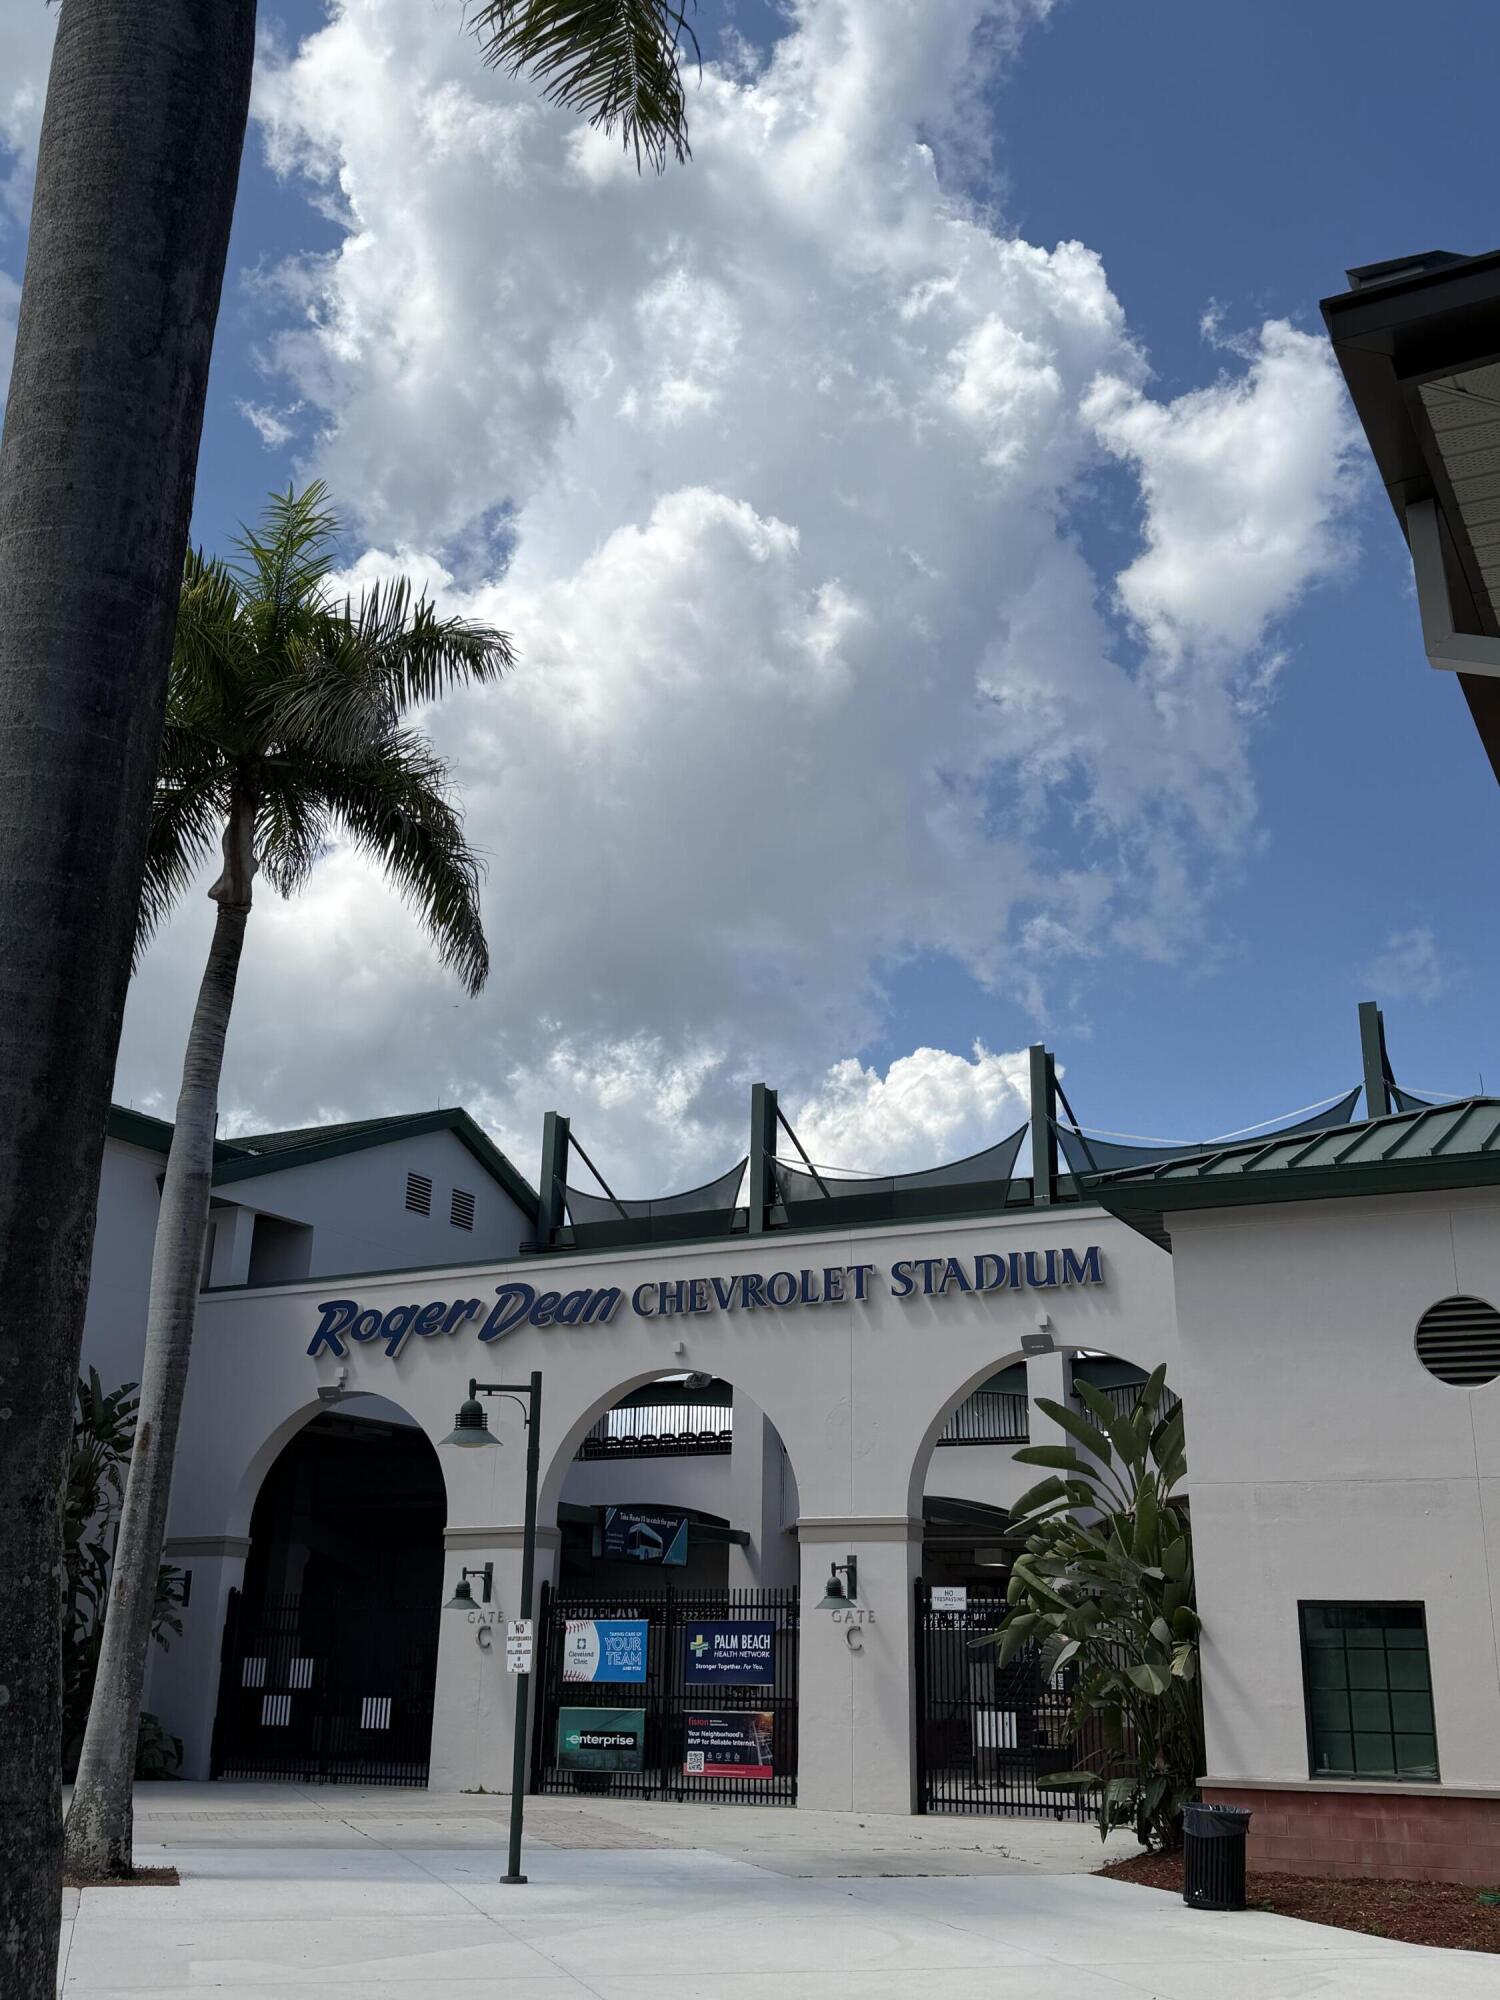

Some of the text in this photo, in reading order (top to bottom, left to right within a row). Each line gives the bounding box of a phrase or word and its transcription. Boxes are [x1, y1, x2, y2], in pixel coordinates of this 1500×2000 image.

[306, 1245, 1104, 1358] Roger Dean CHEVROLET STADIUM
[467, 1611, 504, 1624] GATE
[831, 1610, 876, 1624] GATE
[515, 1624, 524, 1633] NO
[477, 1625, 491, 1649] C
[604, 1637, 642, 1651] YOUR
[714, 1634, 770, 1650] PALM BEACH
[847, 1625, 863, 1651] C
[606, 1651, 642, 1666] TEAM
[713, 1650, 770, 1658] HEALTH NETWORK
[566, 1733, 634, 1747] enterprise
